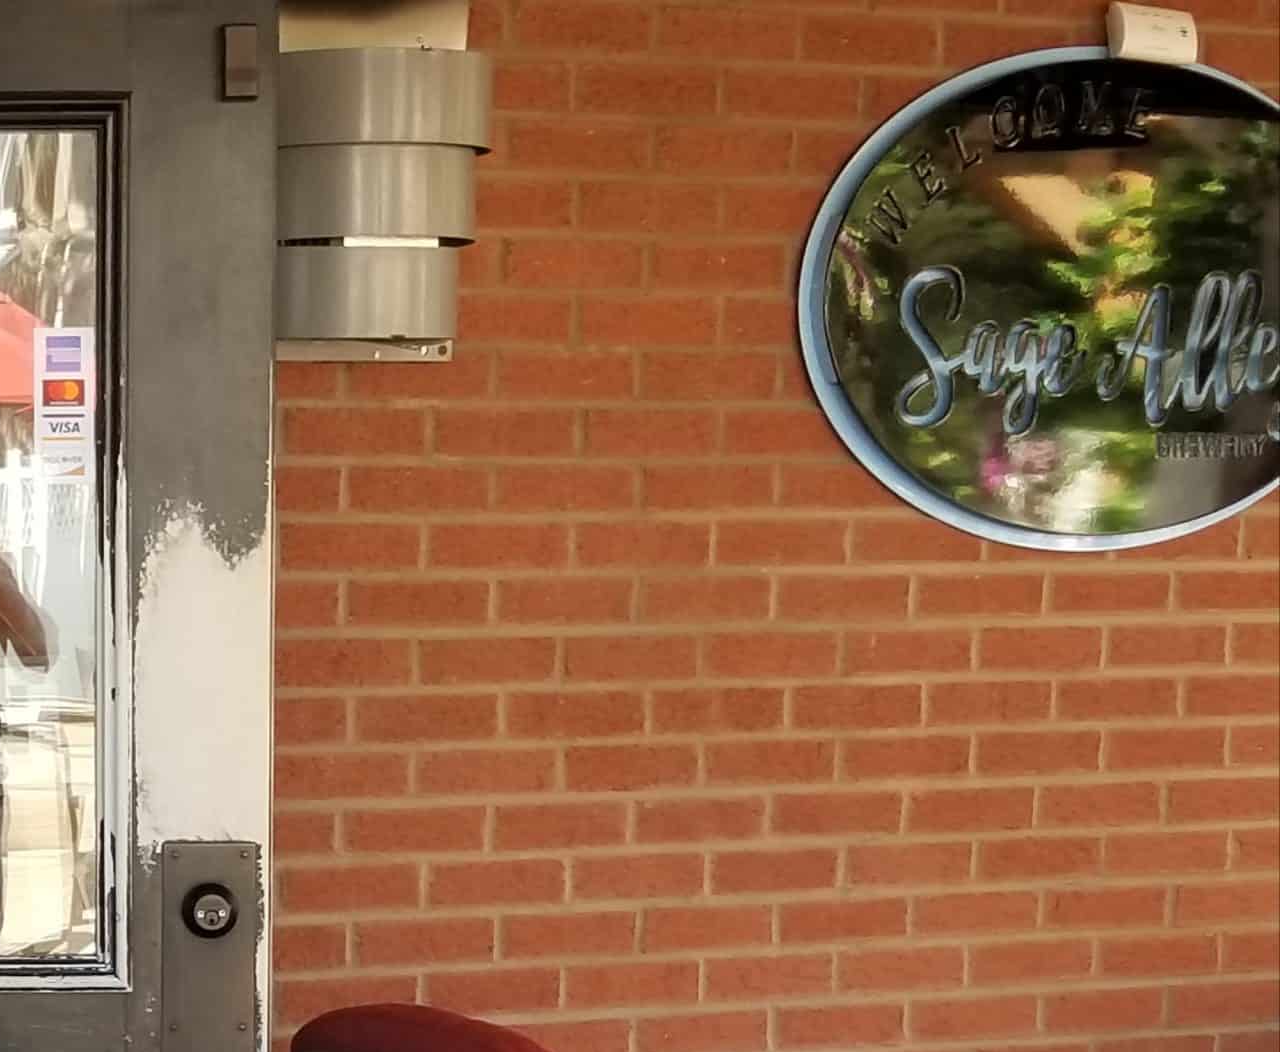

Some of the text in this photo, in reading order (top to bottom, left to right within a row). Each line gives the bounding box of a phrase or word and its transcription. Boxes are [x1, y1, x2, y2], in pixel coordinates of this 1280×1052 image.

[864, 79, 1154, 246] WELCOME
[48, 421, 81, 433] VISA
[895, 264, 1280, 440] Sage Alle
